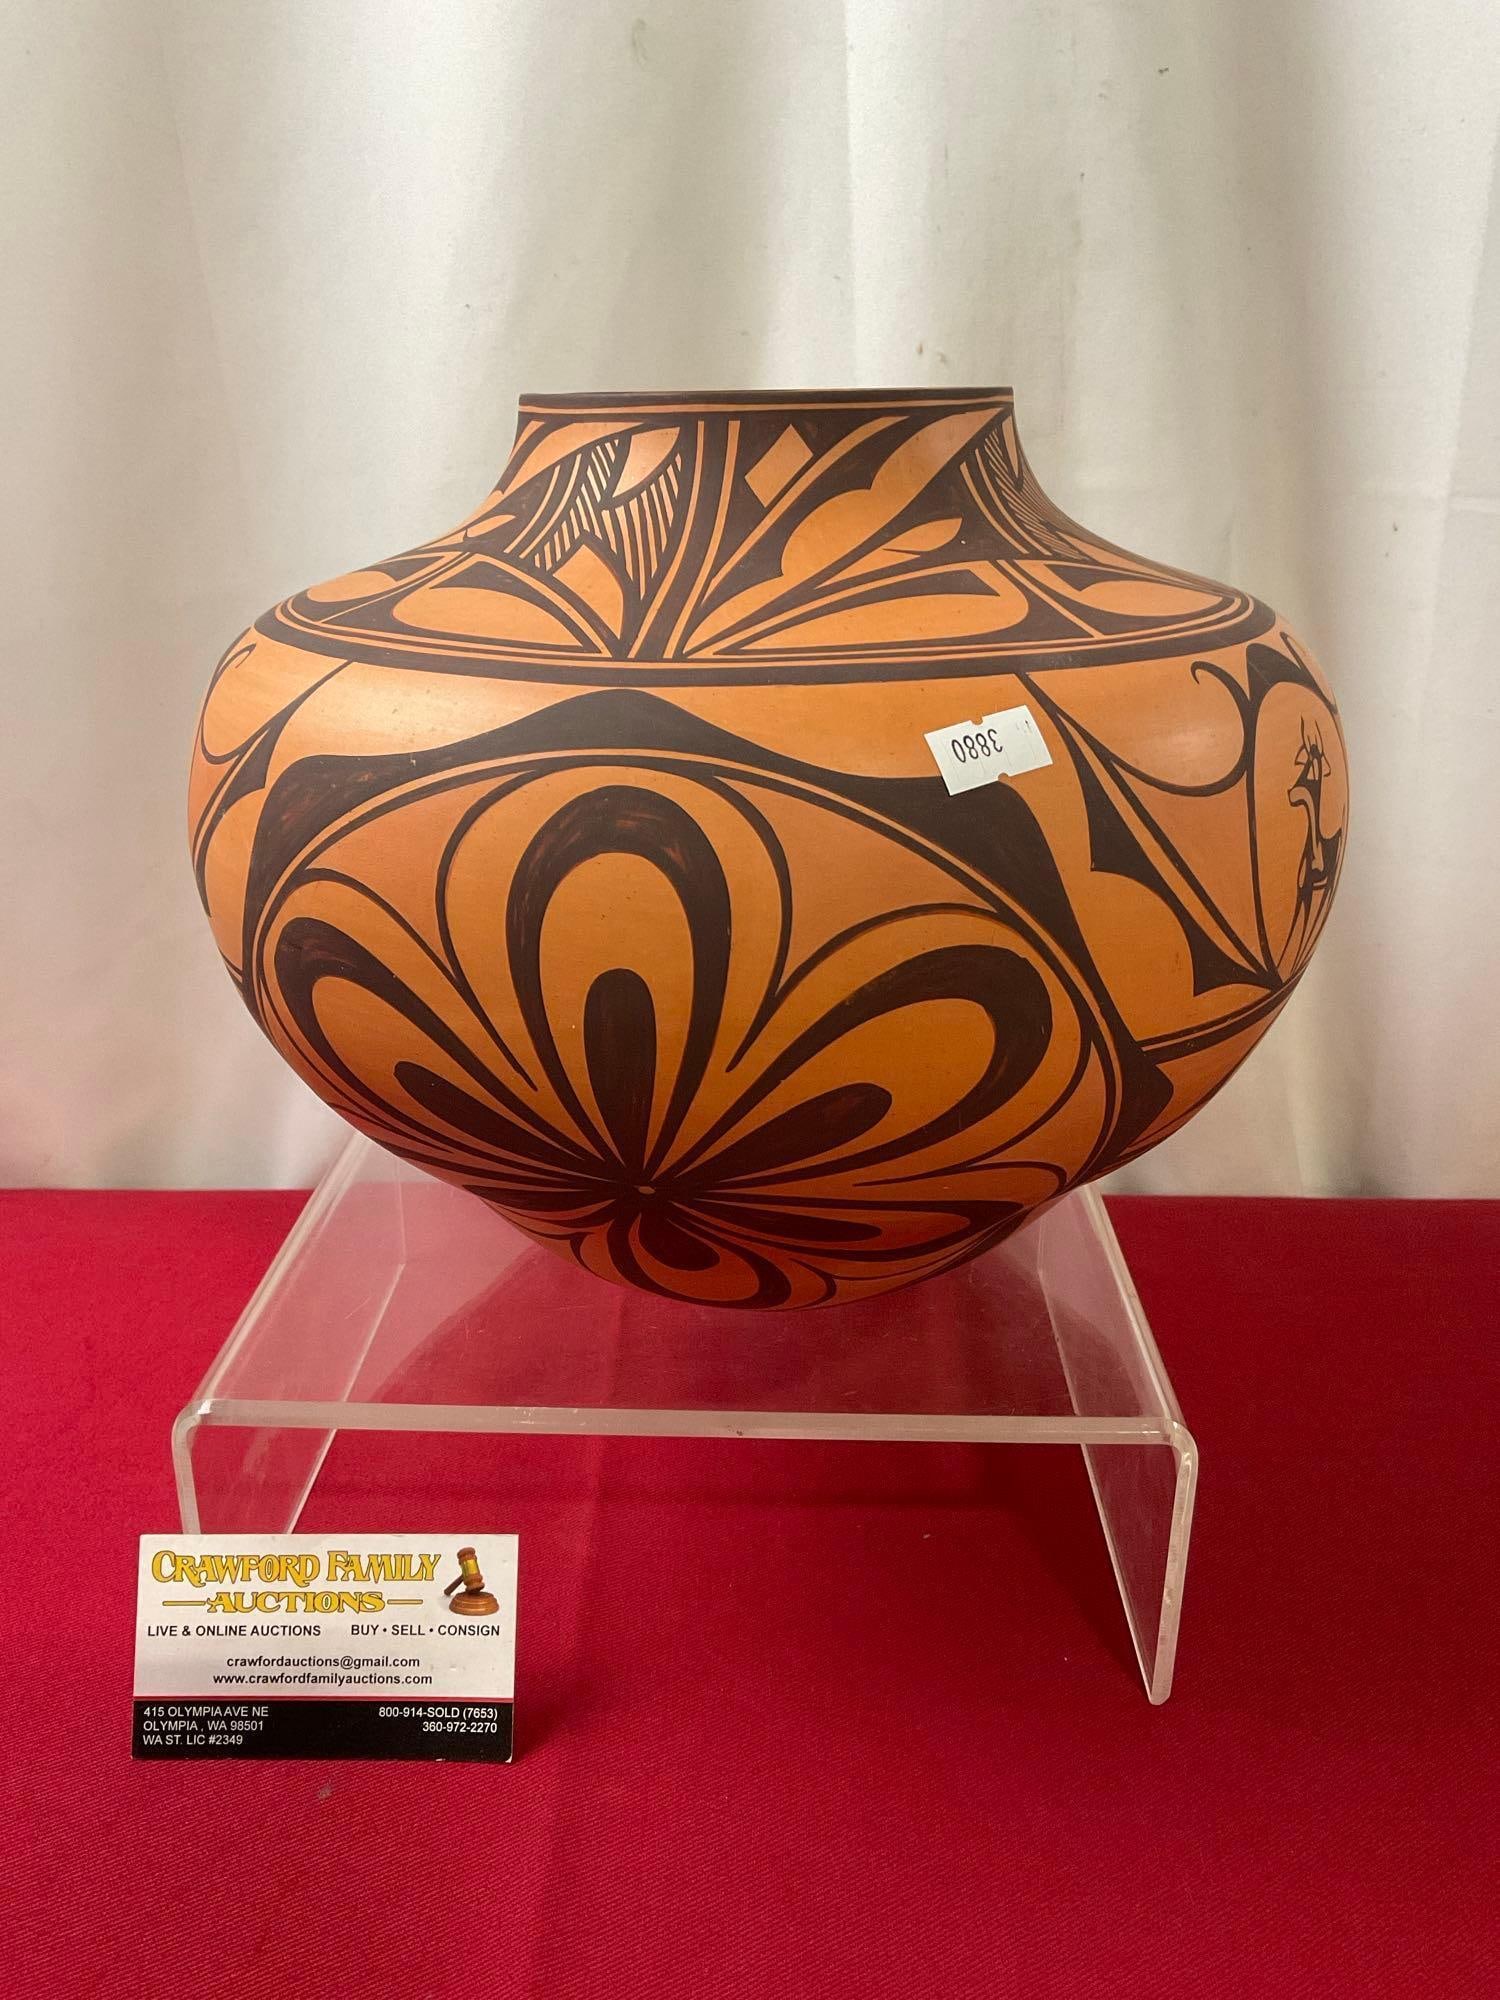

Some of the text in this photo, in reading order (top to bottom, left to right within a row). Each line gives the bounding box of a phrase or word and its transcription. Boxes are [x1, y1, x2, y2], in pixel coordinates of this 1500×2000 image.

[951, 728, 1003, 763] 3880
[151, 1550, 441, 1587] CRAWFORD FAMILY
[206, 1591, 386, 1614] AUCTIONS
[147, 1624, 321, 1637] LIVE & ONLINE AUCTIONS
[351, 1624, 501, 1636] BUY SELL CONSIGN
[227, 1656, 420, 1669] crawfordauctions@gmail.com
[214, 1673, 432, 1685] www.crawfordfamilyauctions.com
[144, 1706, 269, 1718] 415 OLYMPIA AVE NE
[379, 1706, 498, 1720] 800-914-SOLD (7653)
[207, 1720, 228, 1731] WA
[230, 1720, 264, 1731] 98501
[422, 1721, 497, 1733] 360-972-2270
[143, 1734, 243, 1745] WA ST. LIC #2349
